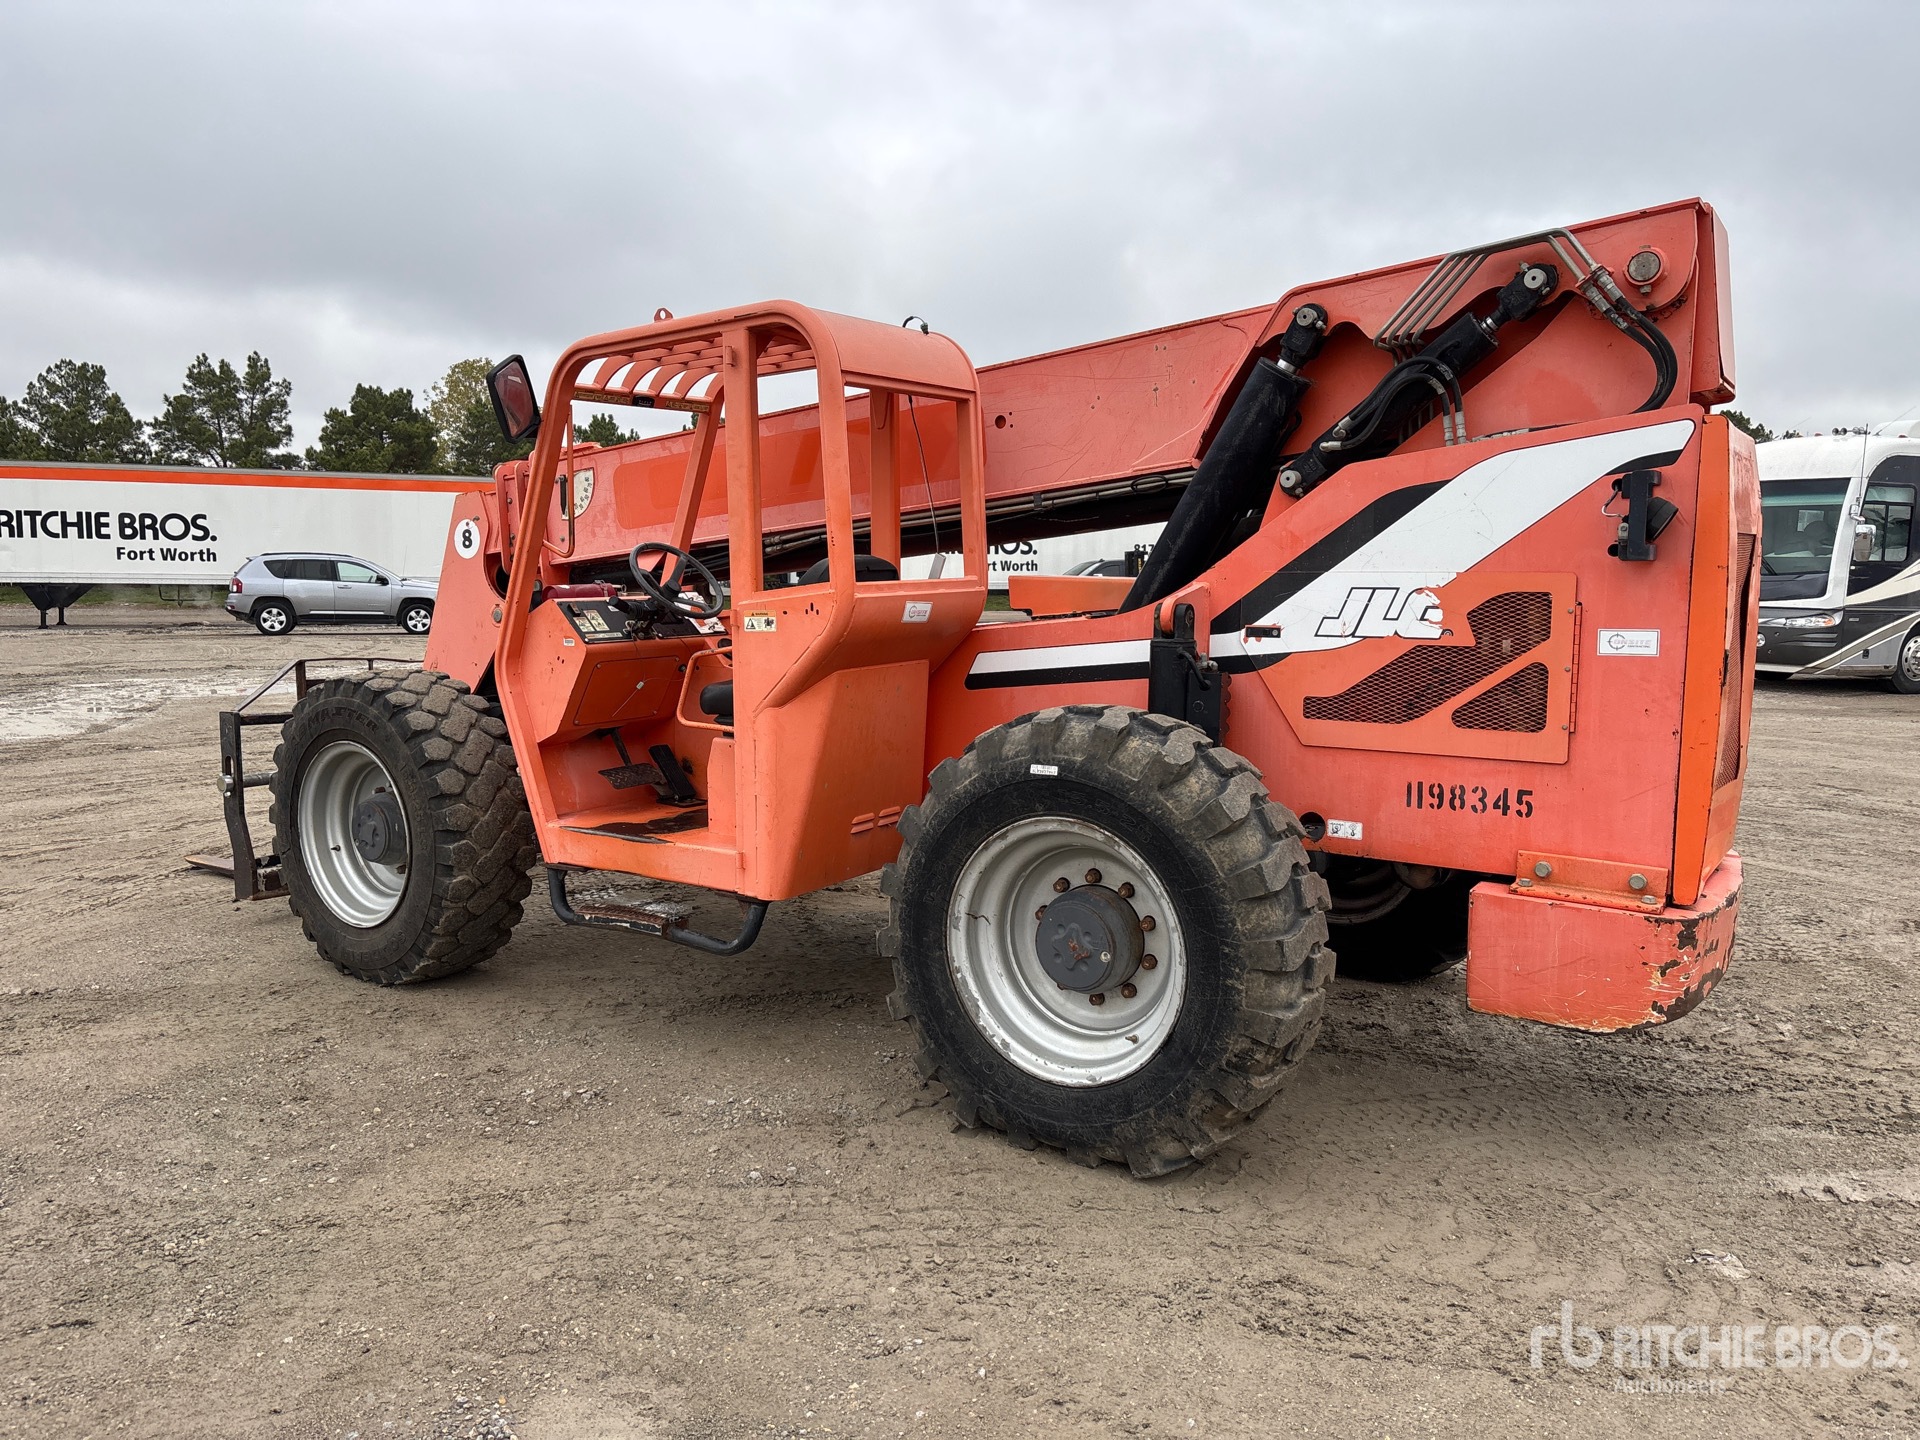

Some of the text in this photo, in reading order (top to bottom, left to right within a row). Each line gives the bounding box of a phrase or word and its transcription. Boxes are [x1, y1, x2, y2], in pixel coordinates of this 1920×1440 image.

[0, 510, 217, 542] RITCHIE BROS.
[462, 529, 473, 549] 8
[116, 546, 217, 562] Fort Worth
[1000, 560, 1038, 571] Worth
[1406, 781, 1533, 819] 1198345
